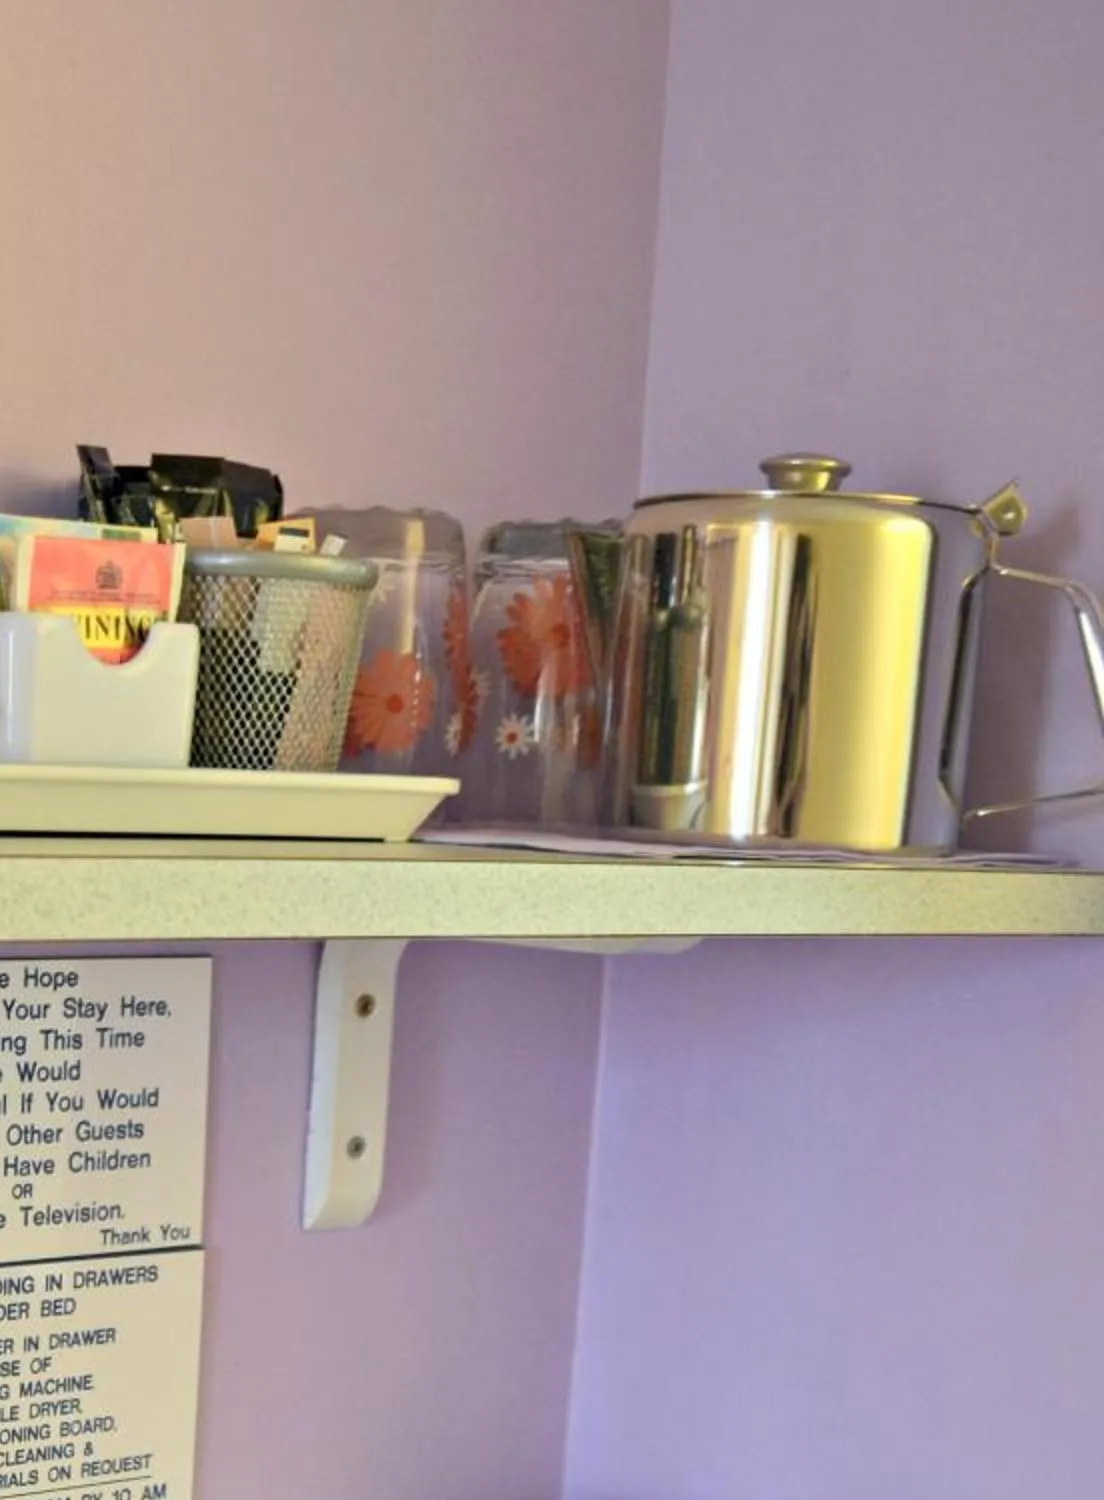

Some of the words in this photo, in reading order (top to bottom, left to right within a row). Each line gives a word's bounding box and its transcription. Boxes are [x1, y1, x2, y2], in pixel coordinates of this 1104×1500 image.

[24, 968, 79, 991] Hope
[3, 999, 49, 1020] Your
[63, 998, 108, 1022] Stay
[41, 1029, 82, 1051] This
[96, 1028, 145, 1048] Time
[17, 1060, 81, 1082] Would
[20, 1094, 33, 1114] If
[46, 1092, 83, 1113] You
[97, 1089, 159, 1109] Would
[6, 1126, 62, 1146] Other
[75, 1120, 144, 1142] Guests
[4, 1156, 55, 1177] Have
[69, 1150, 151, 1173] Children
[12, 1183, 33, 1200] OR
[101, 1226, 149, 1246] Thank
[160, 1225, 190, 1241] You
[45, 1274, 62, 1291] IN
[73, 1266, 158, 1288] DRAWERS
[41, 1298, 75, 1316] BED
[24, 1336, 39, 1352] IN
[50, 1328, 116, 1348] DRAWER
[30, 1358, 52, 1375] OF
[84, 1443, 93, 1457] &
[48, 1466, 71, 1481] ON
[81, 1455, 152, 1477] REQUEST
[141, 1484, 167, 1500] AM
